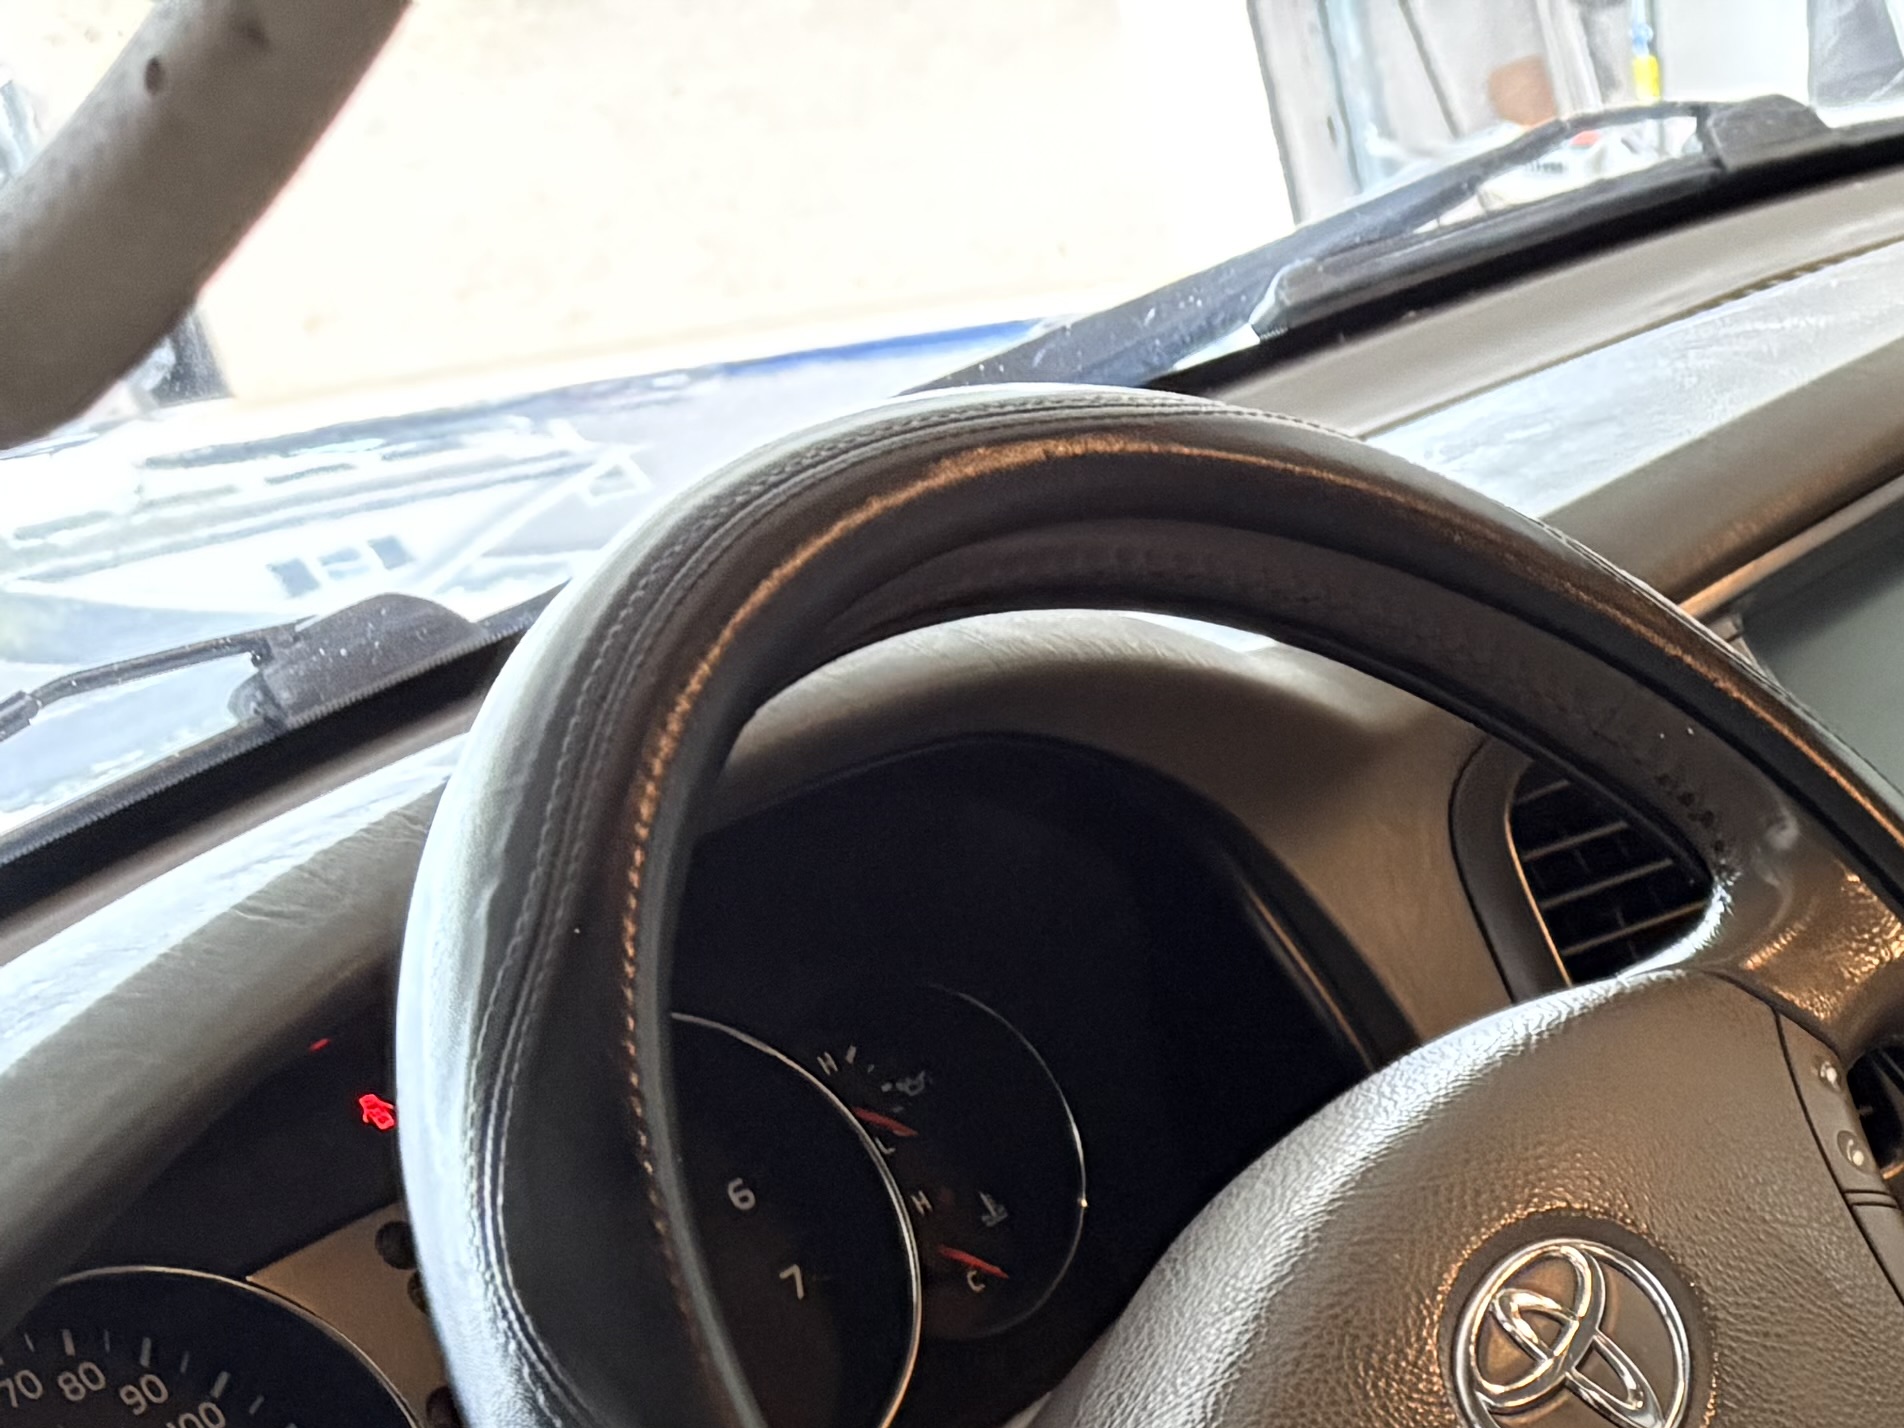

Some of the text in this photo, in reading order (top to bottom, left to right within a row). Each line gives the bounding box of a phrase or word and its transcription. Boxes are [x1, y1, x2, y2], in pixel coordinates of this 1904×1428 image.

[727, 1178, 755, 1210] 6
[911, 1190, 933, 1216] H
[779, 1264, 804, 1299] 7
[0, 1369, 43, 1407] 70
[57, 1361, 106, 1401] 80
[119, 1374, 169, 1415] 90
